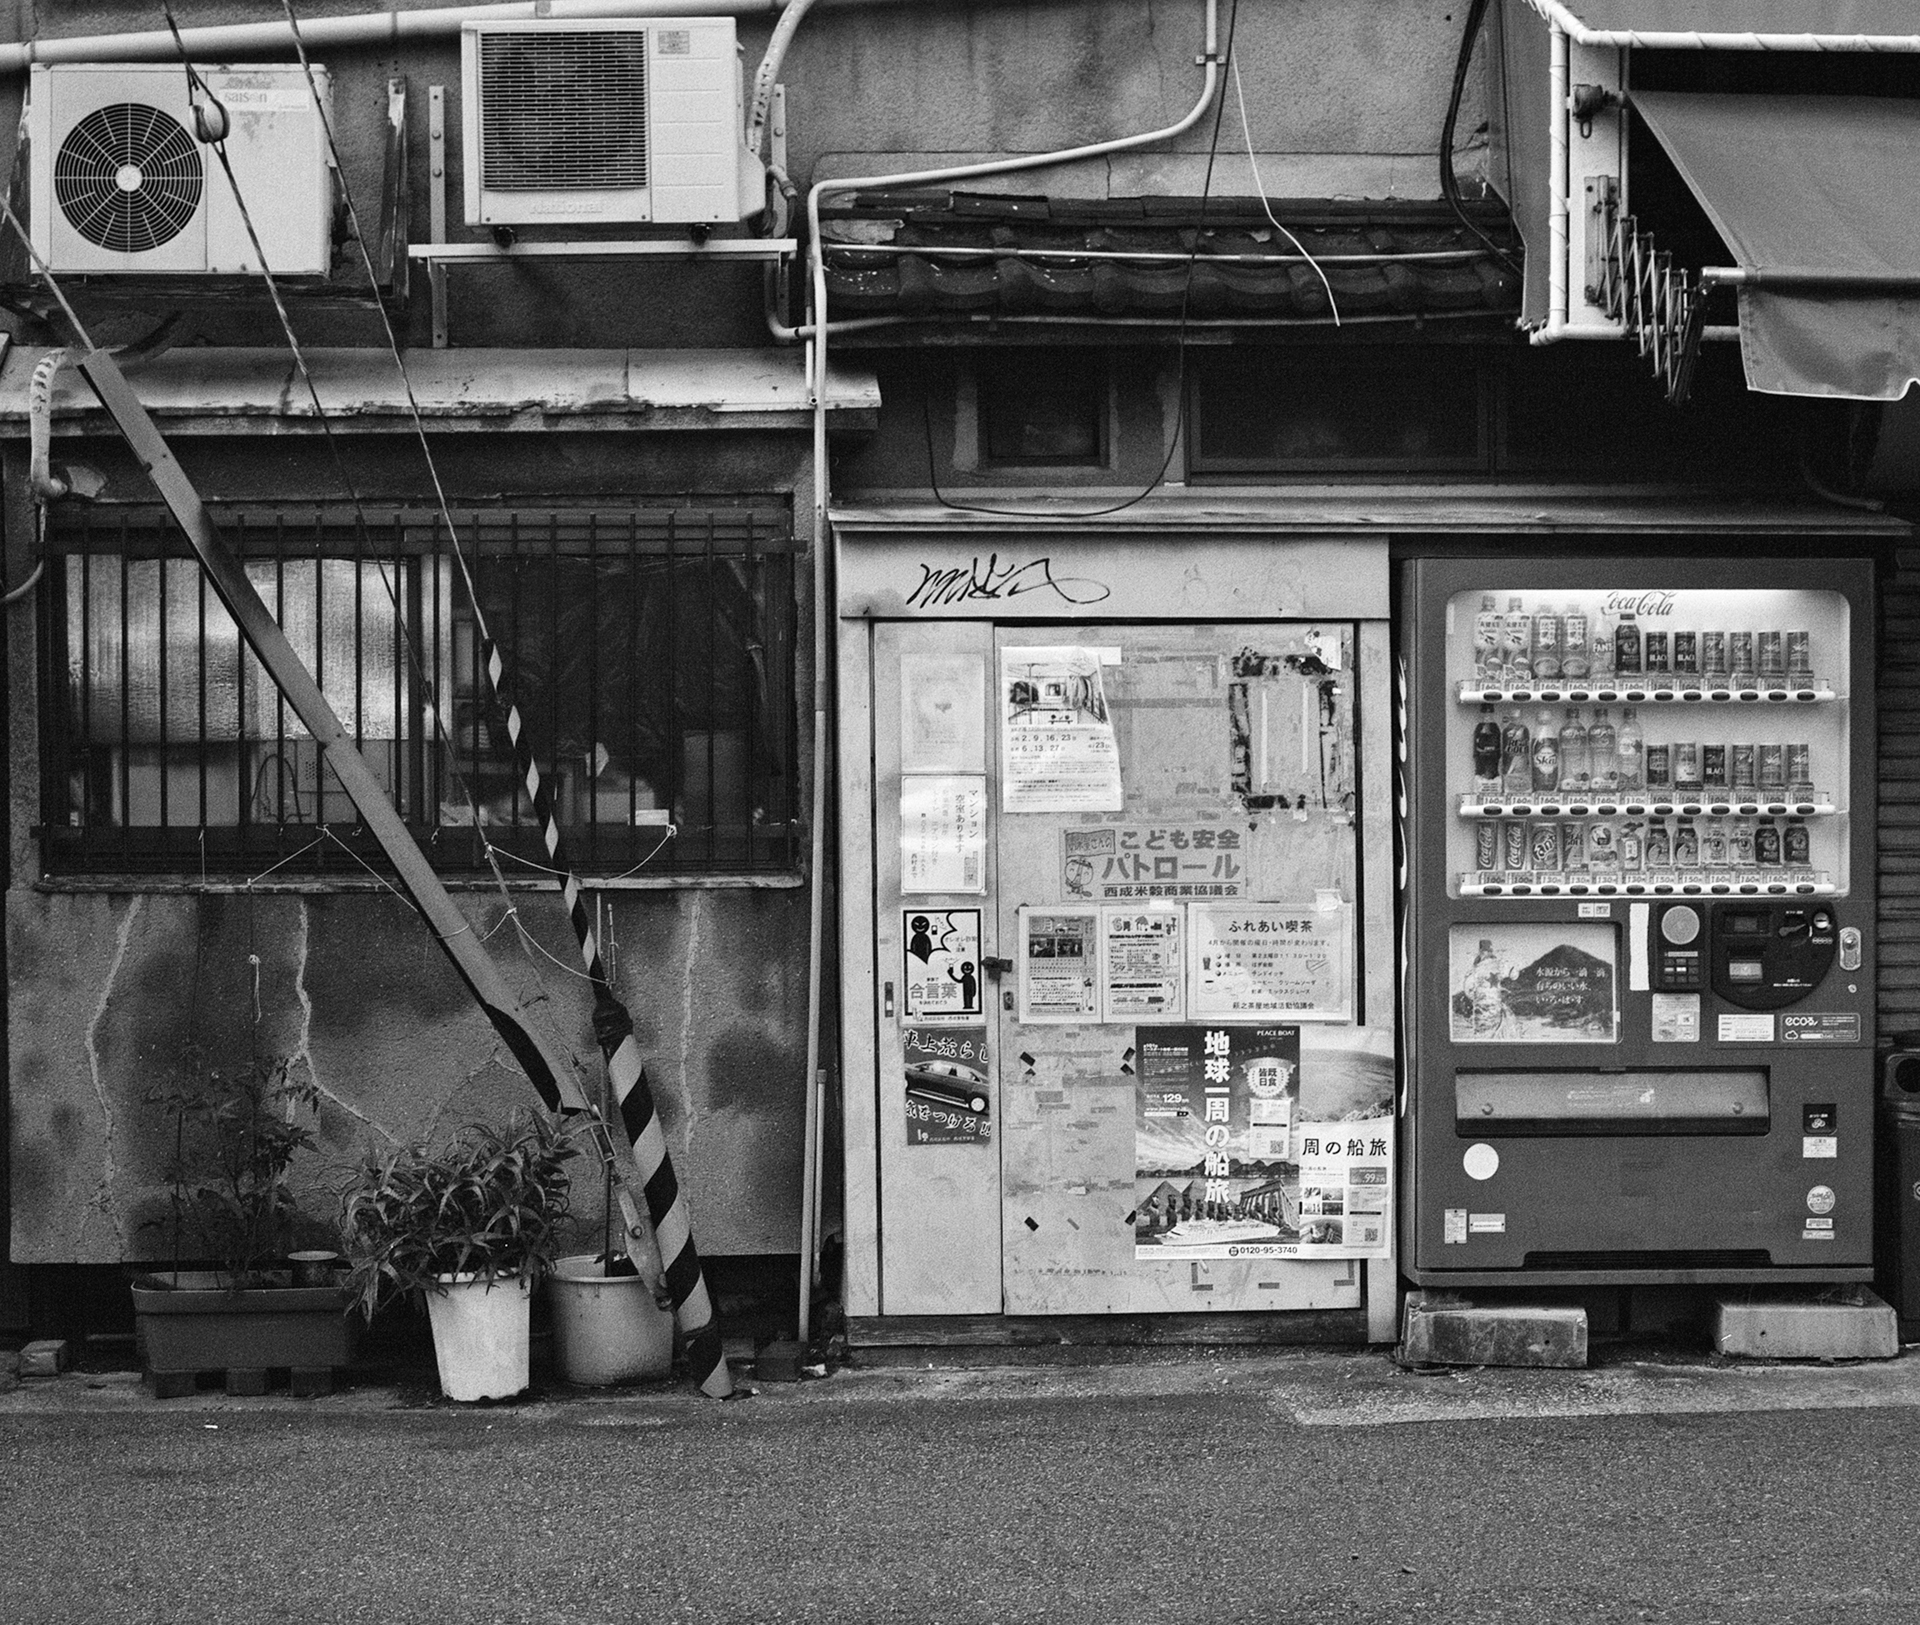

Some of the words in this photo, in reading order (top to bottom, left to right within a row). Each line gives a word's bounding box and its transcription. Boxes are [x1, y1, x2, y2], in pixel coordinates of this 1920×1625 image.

[1601, 590, 1678, 616] Coca-Cola
[1649, 654, 1668, 662] BLAC
[1677, 654, 1697, 662] BLAC
[968, 789, 979, 838] マンション
[1120, 829, 1241, 850] こども安全
[1532, 834, 1557, 862] Fant
[1101, 853, 1241, 881] パトロール
[1104, 885, 1239, 898] 西成米穀商業協議会
[1228, 920, 1313, 933] ふれあい喫茶
[910, 982, 958, 999] 合言葉
[1204, 1030, 1230, 1203] 地球一周の船旅
[1302, 1138, 1387, 1156] 周の船旅
[1240, 1246, 1298, 1254] 0120-95-3740
